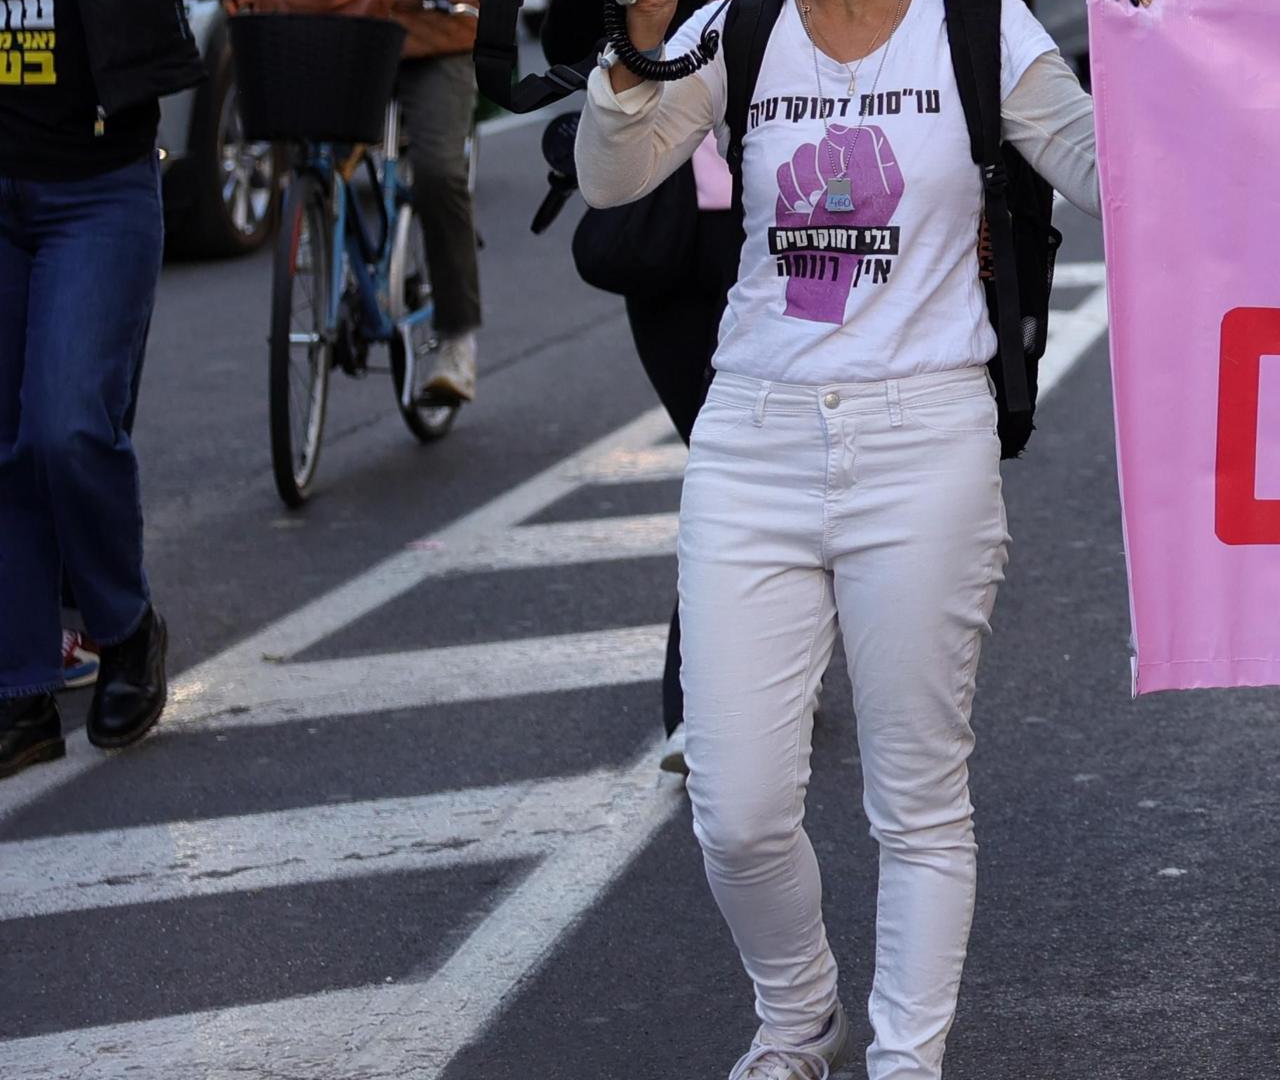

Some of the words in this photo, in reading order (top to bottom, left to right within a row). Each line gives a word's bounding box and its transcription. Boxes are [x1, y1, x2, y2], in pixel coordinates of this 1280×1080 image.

[16, 30, 56, 50] ואני
[749, 95, 851, 129] דמוקרטיה
[858, 88, 941, 118] עו"סות
[828, 196, 851, 209] 460
[775, 228, 858, 251] דמוקרטיה
[864, 228, 891, 251] בלי
[776, 254, 840, 282] רווחה
[853, 258, 892, 288] אין
